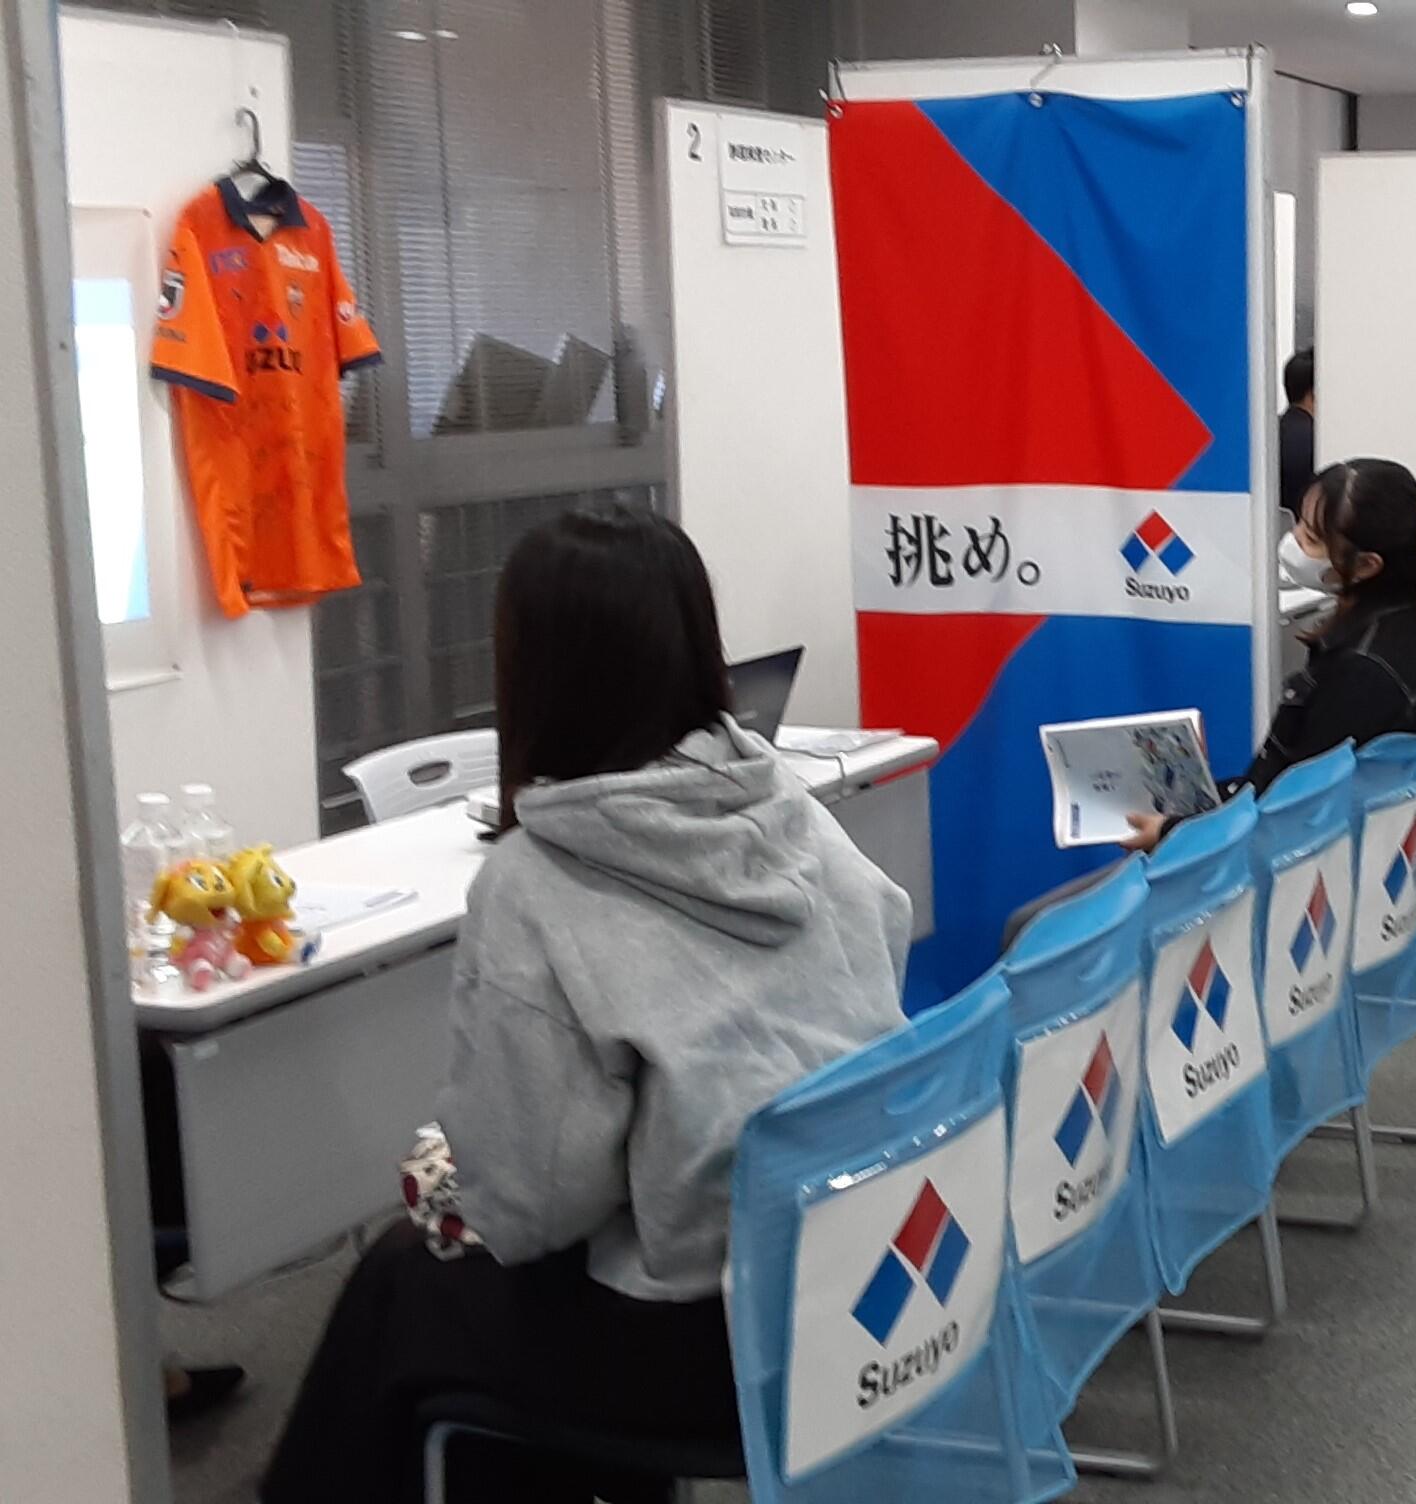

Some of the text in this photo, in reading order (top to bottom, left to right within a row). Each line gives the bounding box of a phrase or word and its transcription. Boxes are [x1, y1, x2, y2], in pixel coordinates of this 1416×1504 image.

[687, 122, 702, 162] 2
[885, 512, 1041, 588] 挑め。
[1124, 576, 1190, 603] Suzuyo
[1182, 1042, 1241, 1099] Suzuyo
[856, 1321, 961, 1409] Suzuyo
